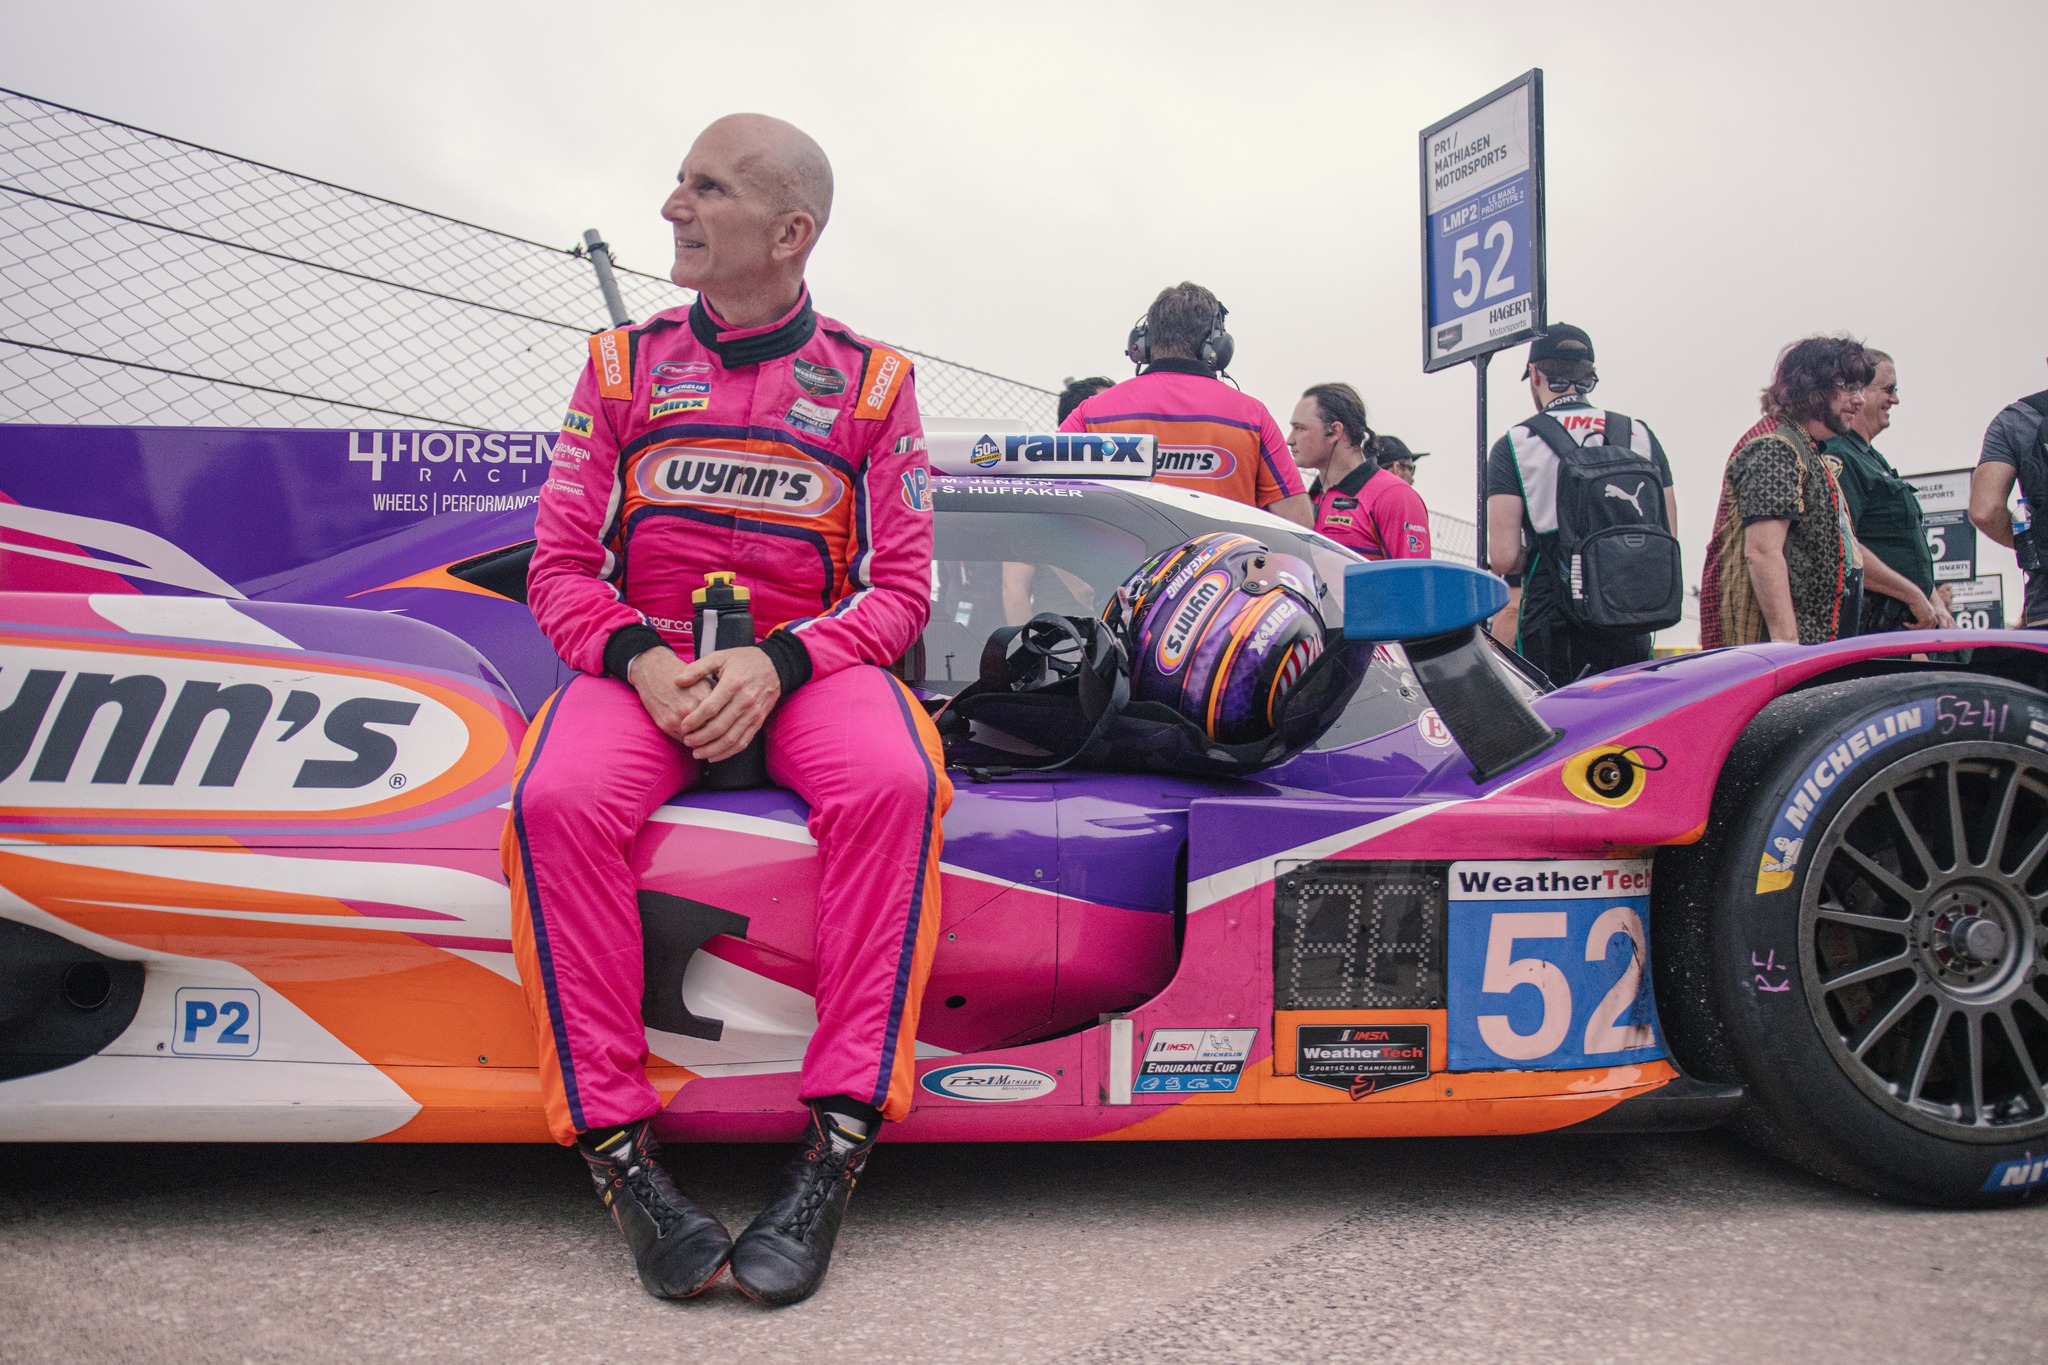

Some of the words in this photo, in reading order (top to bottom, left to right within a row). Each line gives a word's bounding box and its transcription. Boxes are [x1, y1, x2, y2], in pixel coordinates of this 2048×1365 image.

[1434, 137, 1451, 157] PR1
[1435, 134, 1490, 174] MATHIASEN
[1435, 144, 1507, 192] MOTORSPORTS
[1482, 194, 1519, 215] PROTOTYPE
[1488, 194, 1497, 205] LE
[1498, 186, 1516, 200] MANS
[1443, 204, 1478, 233] LMP2
[1453, 220, 1515, 309] 52
[1489, 295, 1533, 324] HAGERTY
[1489, 319, 1527, 338] Motorsports
[599, 334, 623, 386] sparco
[667, 384, 706, 393] MICHELIN
[866, 355, 900, 410] sparco
[1547, 395, 1578, 409] SONY
[665, 459, 813, 503] wynn's
[968, 486, 1084, 498] HUFFAKER
[373, 493, 428, 512] WHEELS
[1166, 554, 1206, 600] KEATING
[1938, 563, 1969, 572] HAGERTY
[1165, 581, 1219, 656] wynn's
[1956, 610, 1990, 630] 60
[1784, 706, 1922, 832] MICHELIN
[1477, 906, 1656, 1060] 52
[182, 1000, 250, 1045] P2
[1166, 1043, 1195, 1051] IMSA
[1354, 1031, 1389, 1040] IMSA
[1303, 1047, 1423, 1059] WeatherTech
